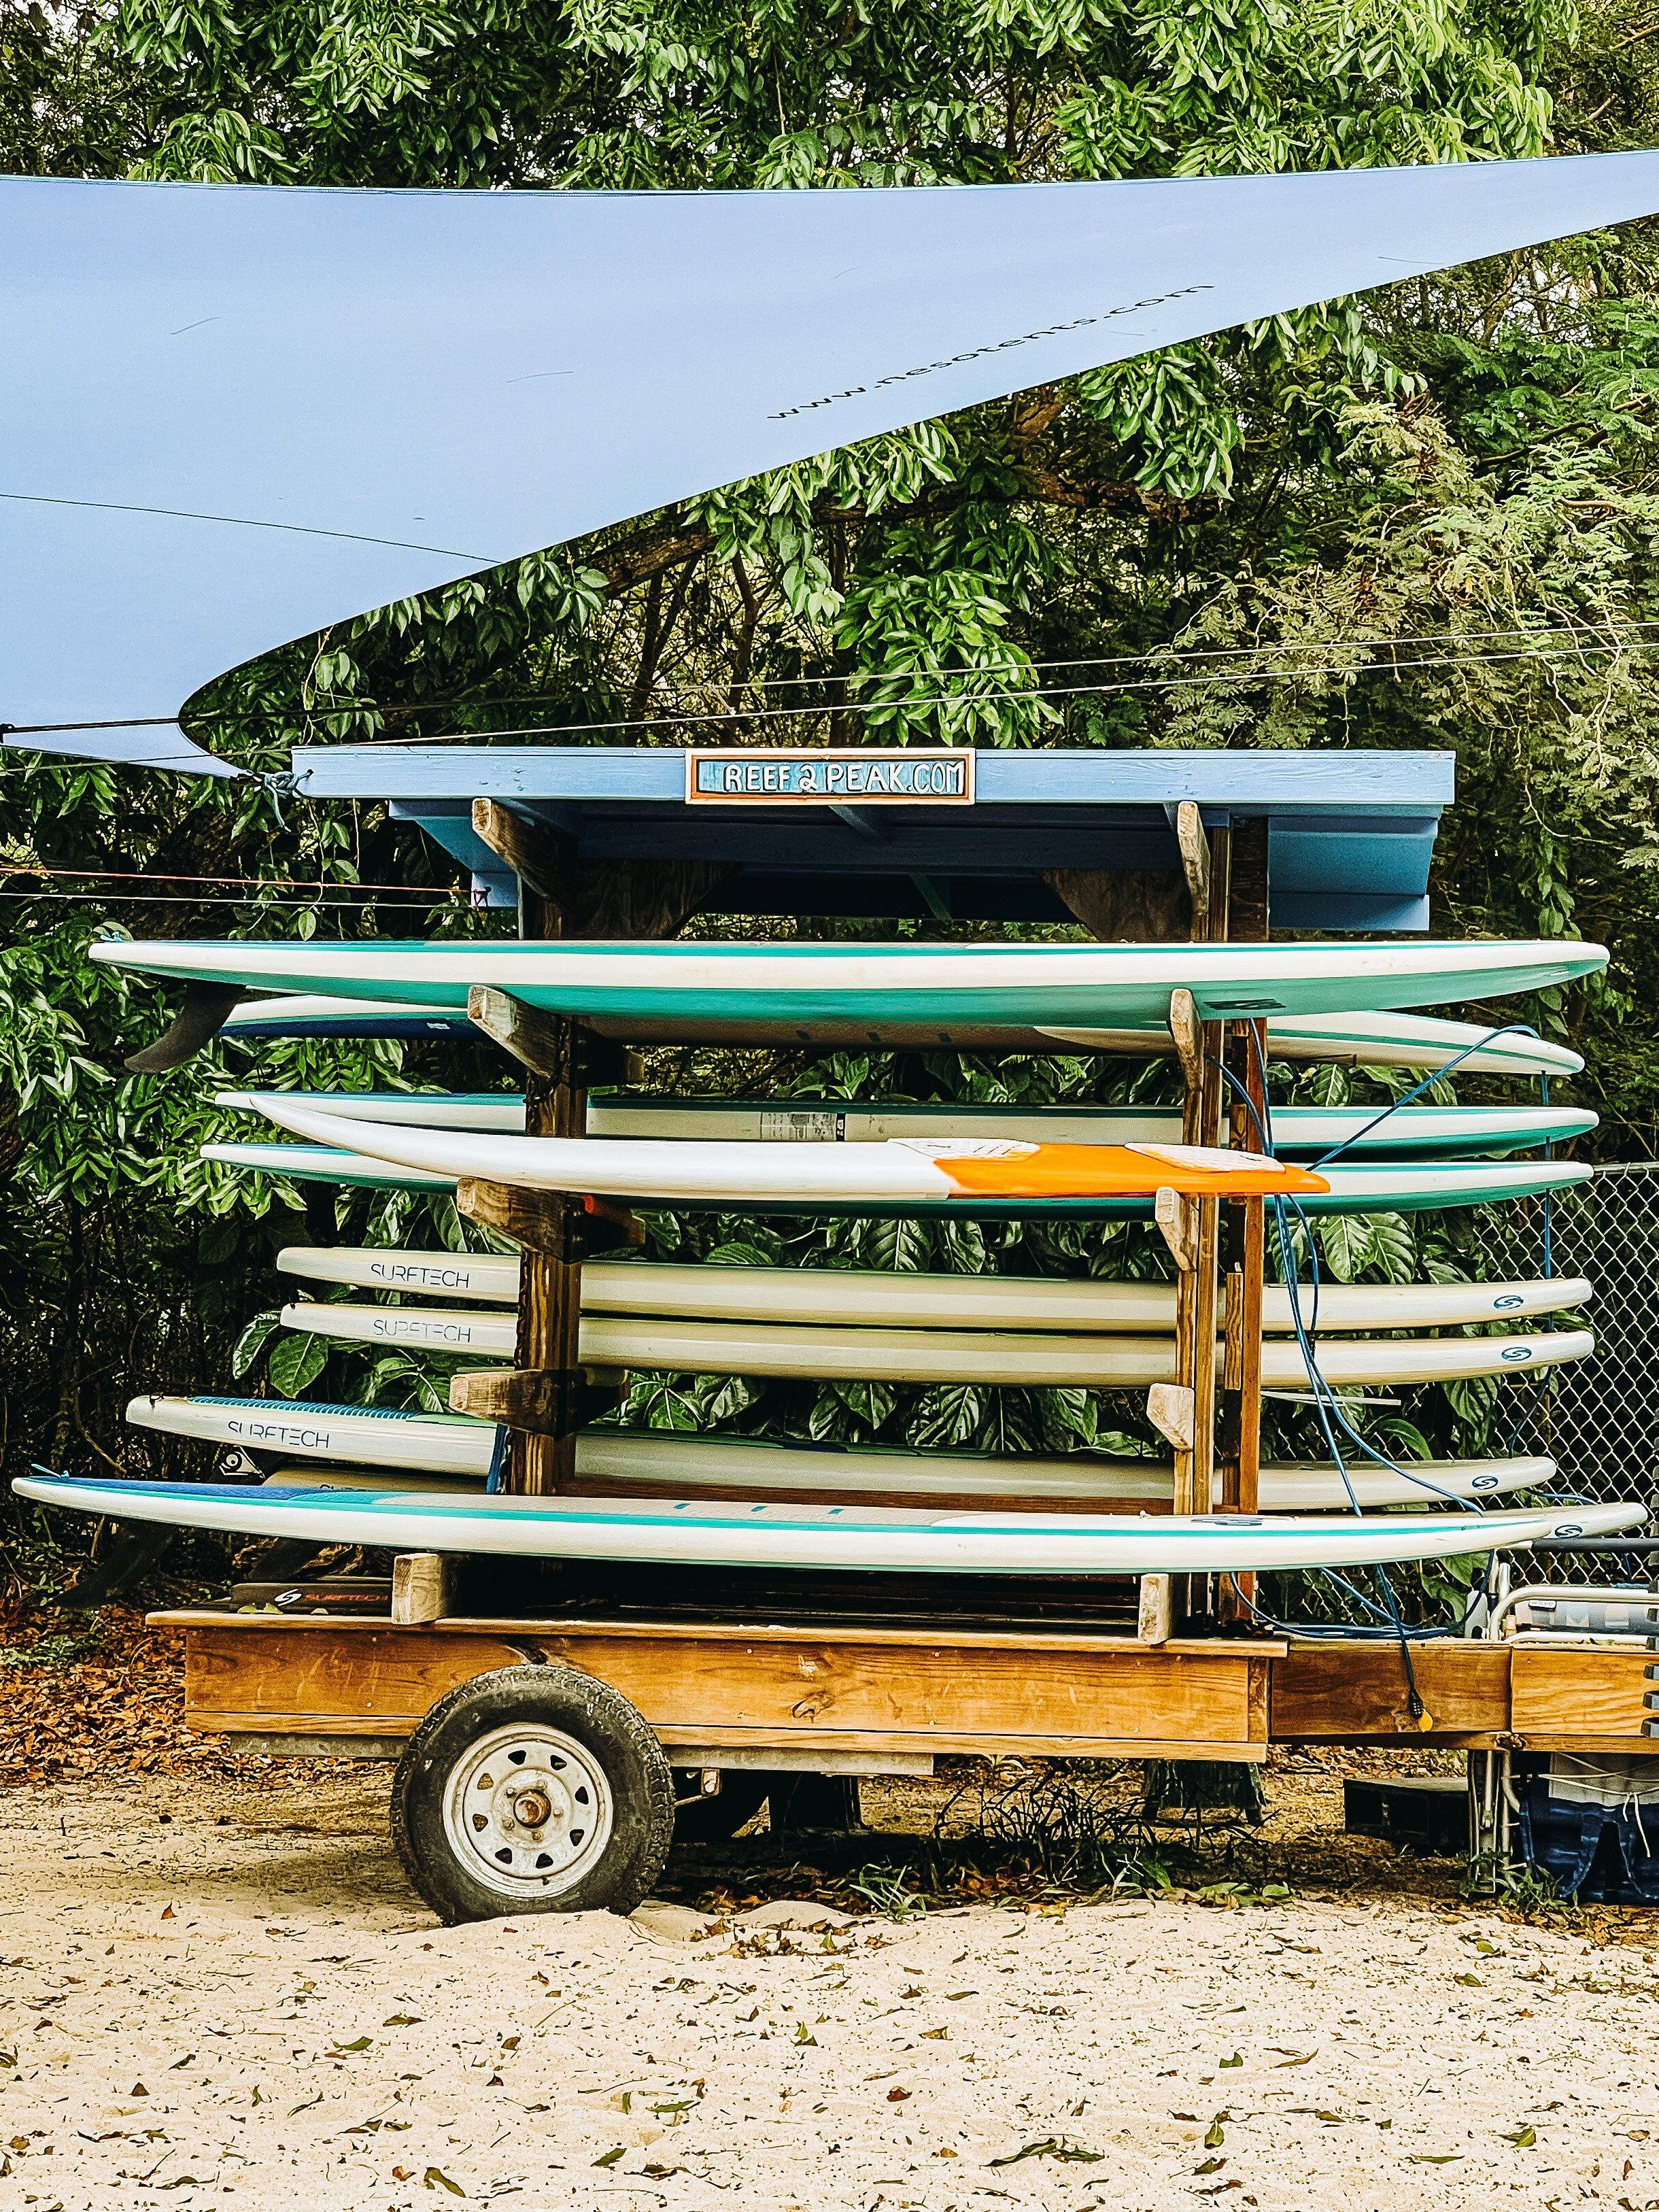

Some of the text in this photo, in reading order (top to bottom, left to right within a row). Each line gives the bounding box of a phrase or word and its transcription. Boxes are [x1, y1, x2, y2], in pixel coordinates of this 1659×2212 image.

[766, 285, 1215, 419] www.nesotents.com
[723, 761, 965, 794] REEF 2 PEAK.COM
[371, 1263, 470, 1289] SURFTECH
